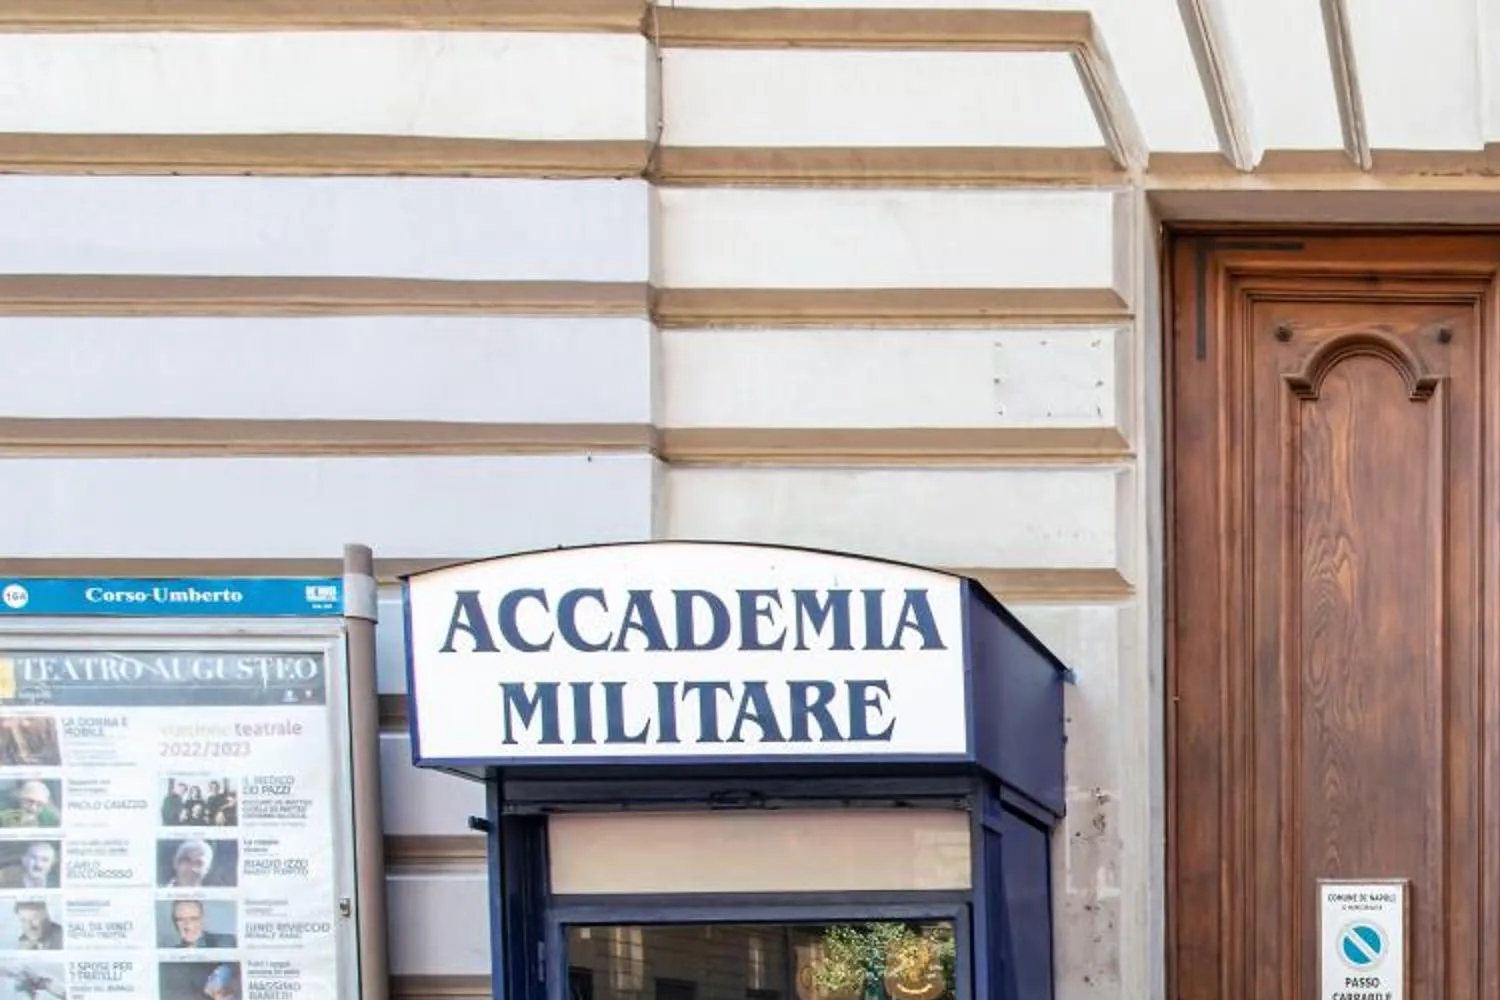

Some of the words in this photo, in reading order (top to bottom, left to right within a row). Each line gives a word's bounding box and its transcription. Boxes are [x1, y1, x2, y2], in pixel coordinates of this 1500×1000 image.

[85, 587, 147, 603] Corso
[152, 587, 243, 603] Umberto
[439, 587, 948, 654] ACCADEMIA
[18, 658, 143, 681] TEATRO
[155, 657, 318, 681] AUGUSTEO
[499, 679, 897, 746] MILITARE
[234, 717, 304, 737] teatrale
[160, 741, 252, 757] 2022/2023
[1345, 977, 1380, 989] PASSO
